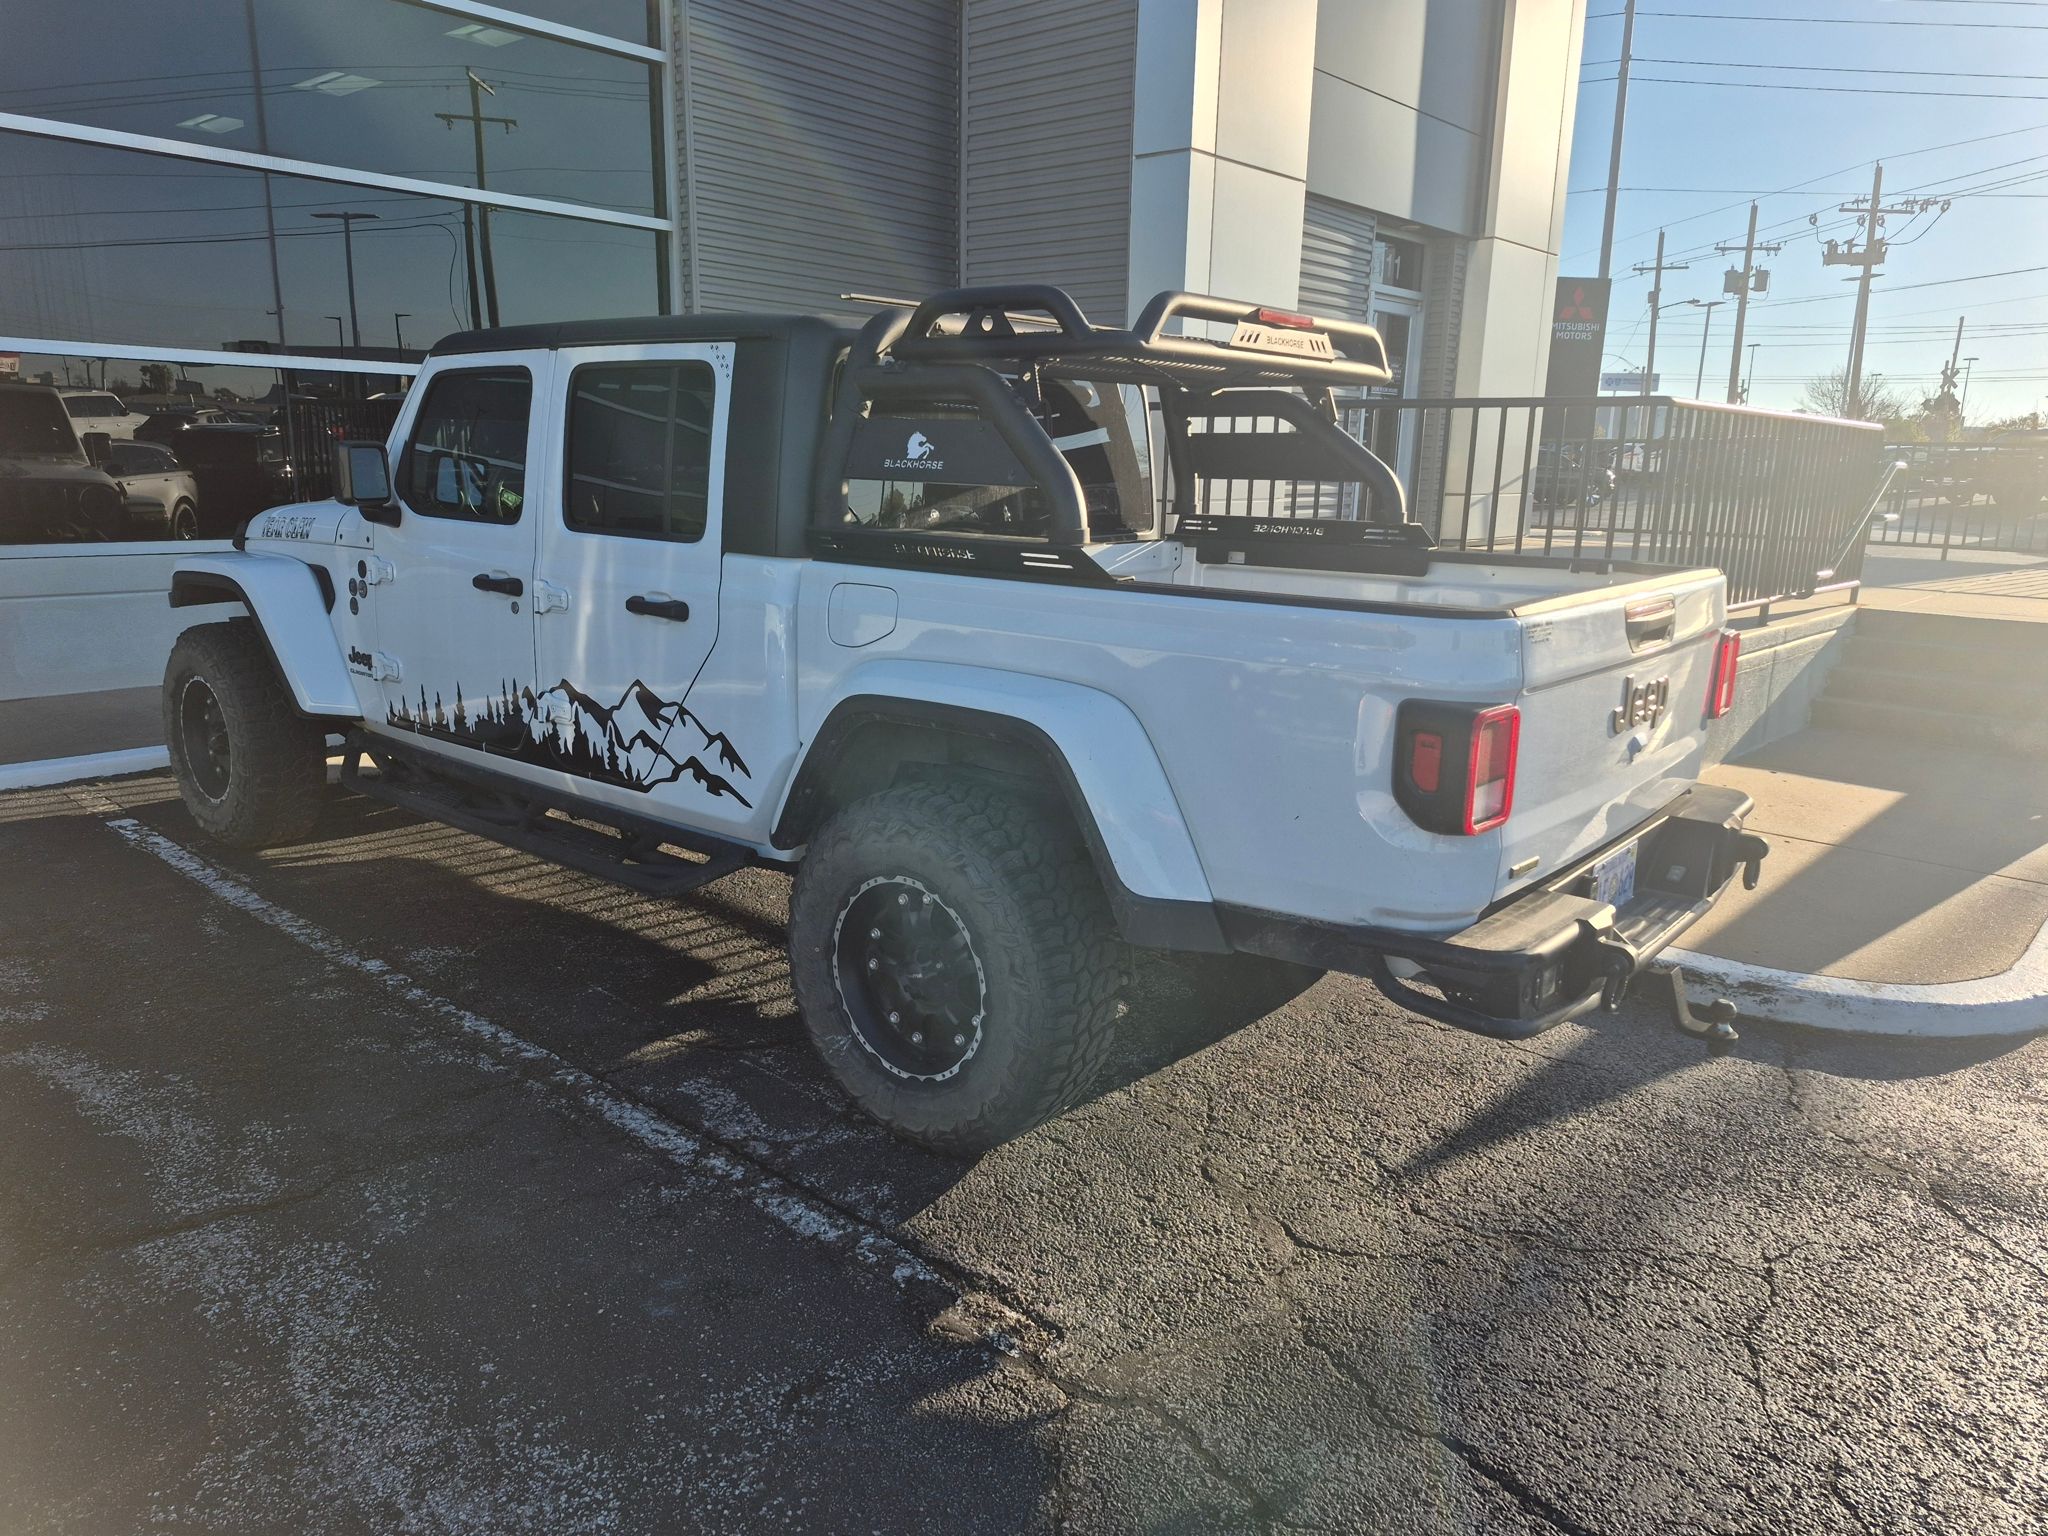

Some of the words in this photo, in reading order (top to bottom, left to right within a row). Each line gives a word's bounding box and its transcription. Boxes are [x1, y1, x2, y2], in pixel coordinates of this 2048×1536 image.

[1552, 321, 1600, 332] MITSUBISHI
[1266, 335, 1305, 349] BLACKHORSE
[1555, 331, 1593, 341] MOTORS
[883, 458, 944, 470] BLACKHORSE
[348, 645, 373, 671] Jeep
[1612, 673, 1670, 734] Jeep
